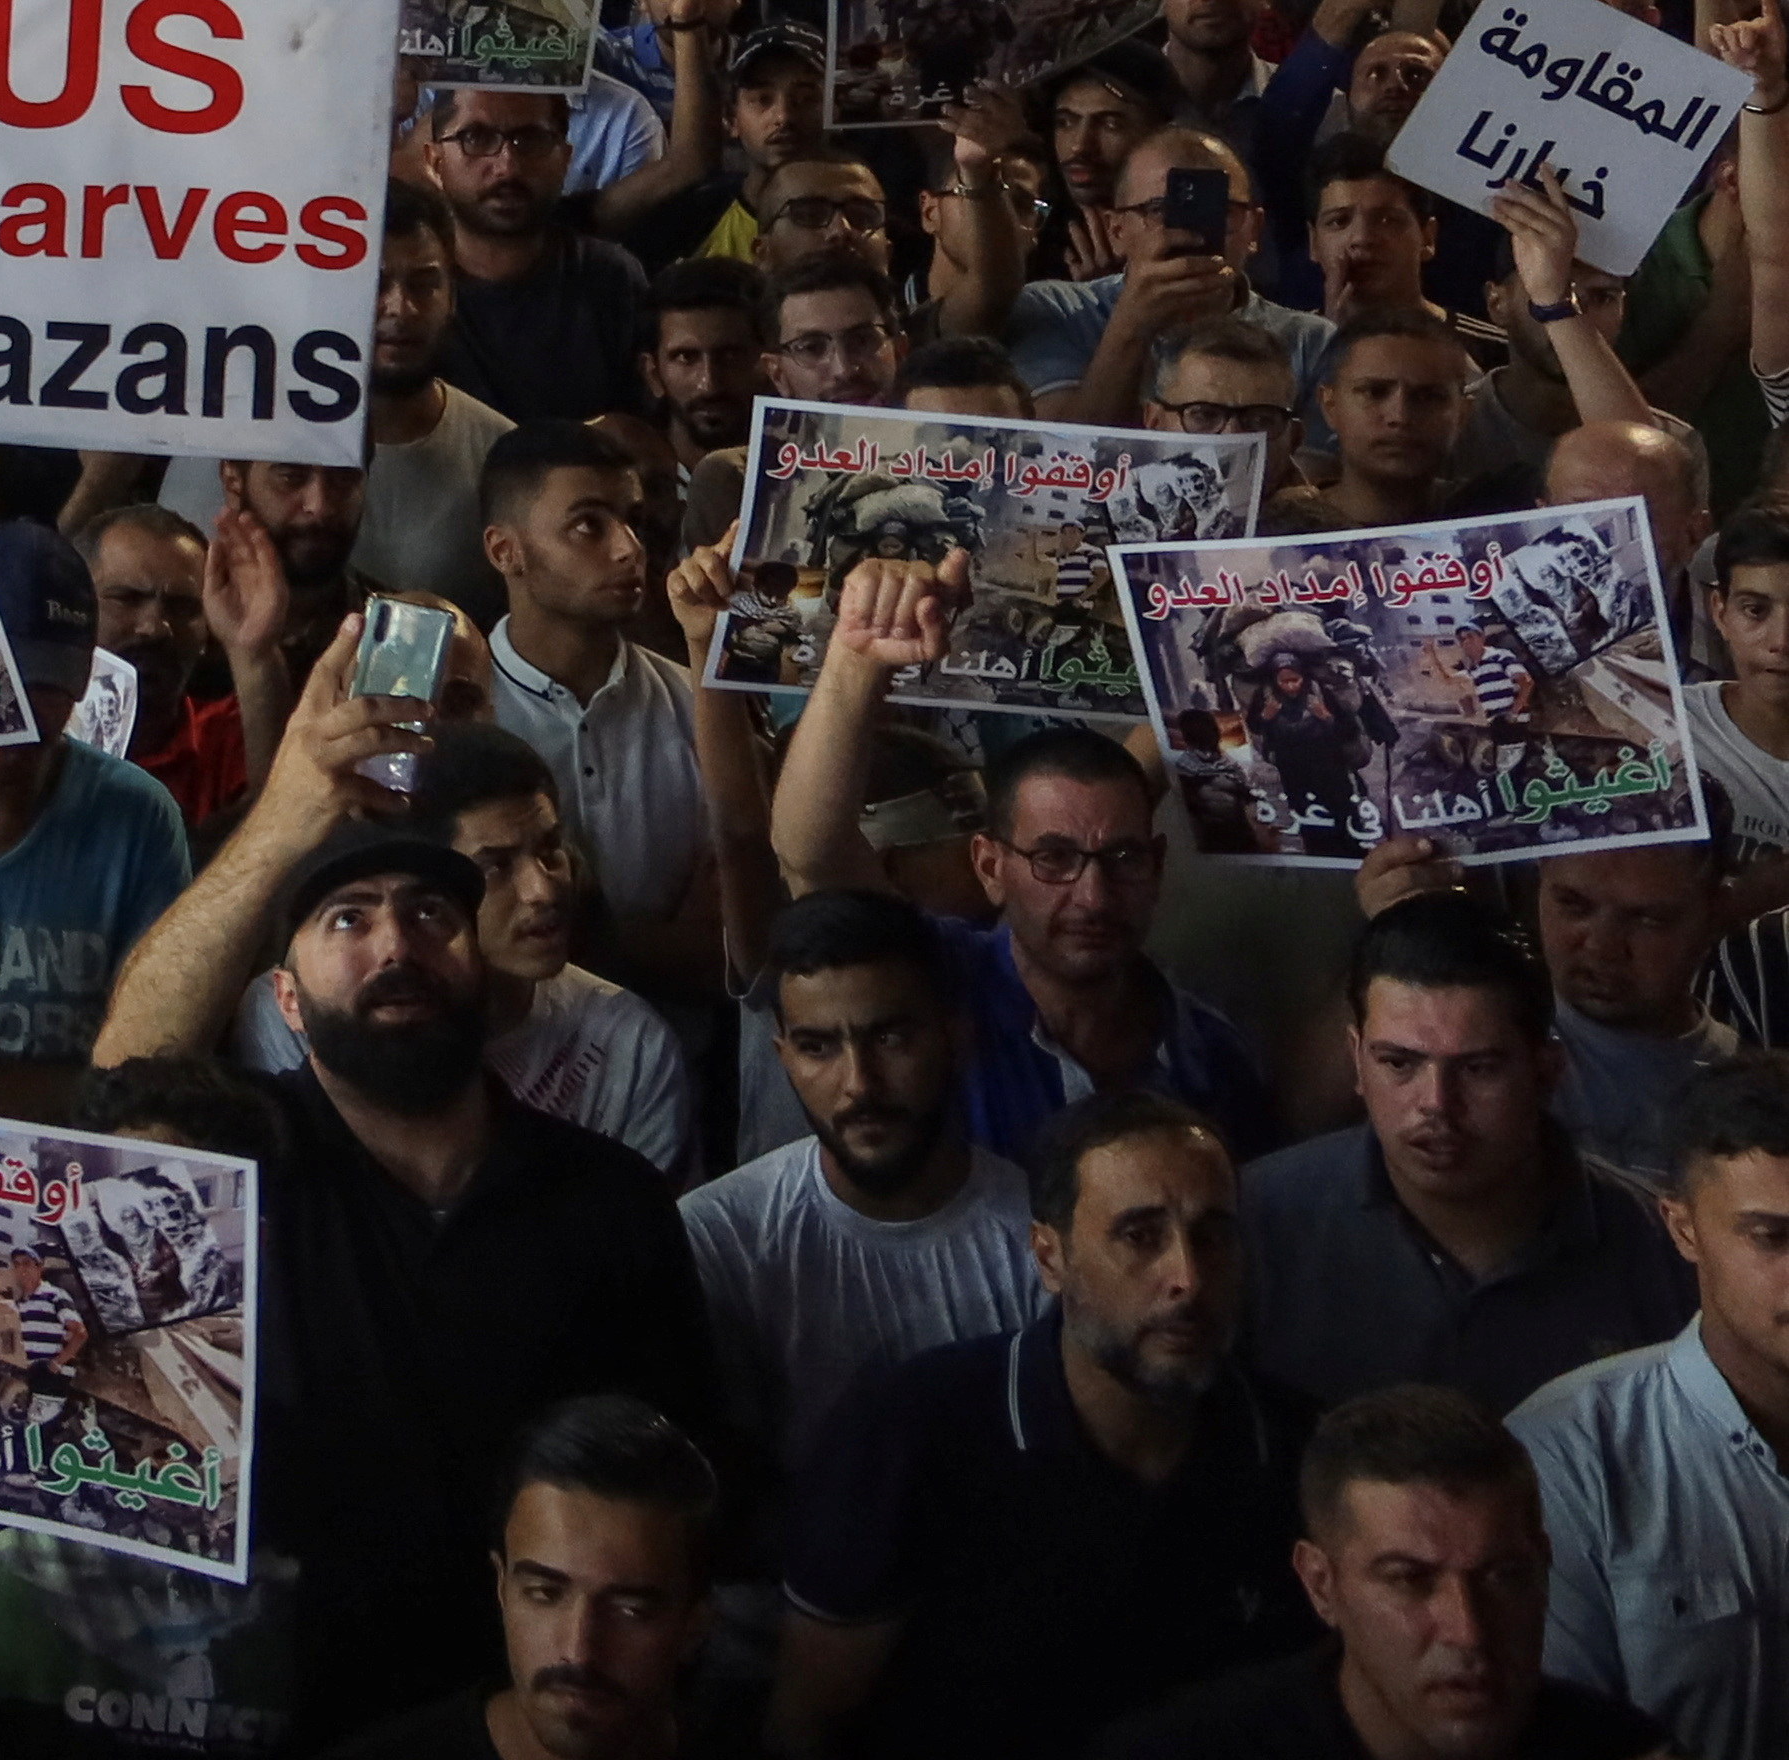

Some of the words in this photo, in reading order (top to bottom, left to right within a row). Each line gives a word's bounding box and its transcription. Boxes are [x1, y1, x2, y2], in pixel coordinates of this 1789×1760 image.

[1478, 6, 1721, 151] المقاومة
[765, 434, 879, 480] العدو
[889, 445, 996, 492] إمداد
[1006, 453, 1133, 504] أوقفوا
[1141, 571, 1244, 621] العدو
[1258, 560, 1364, 610] إمداد
[1372, 541, 1506, 609] أوقفوا
[1392, 779, 1494, 831] أهلنا
[1496, 738, 1674, 824] أغيثوا
[1255, 783, 1336, 835] غزة
[1347, 791, 1384, 848] في
[25, 1422, 223, 1512] أغيثوا
